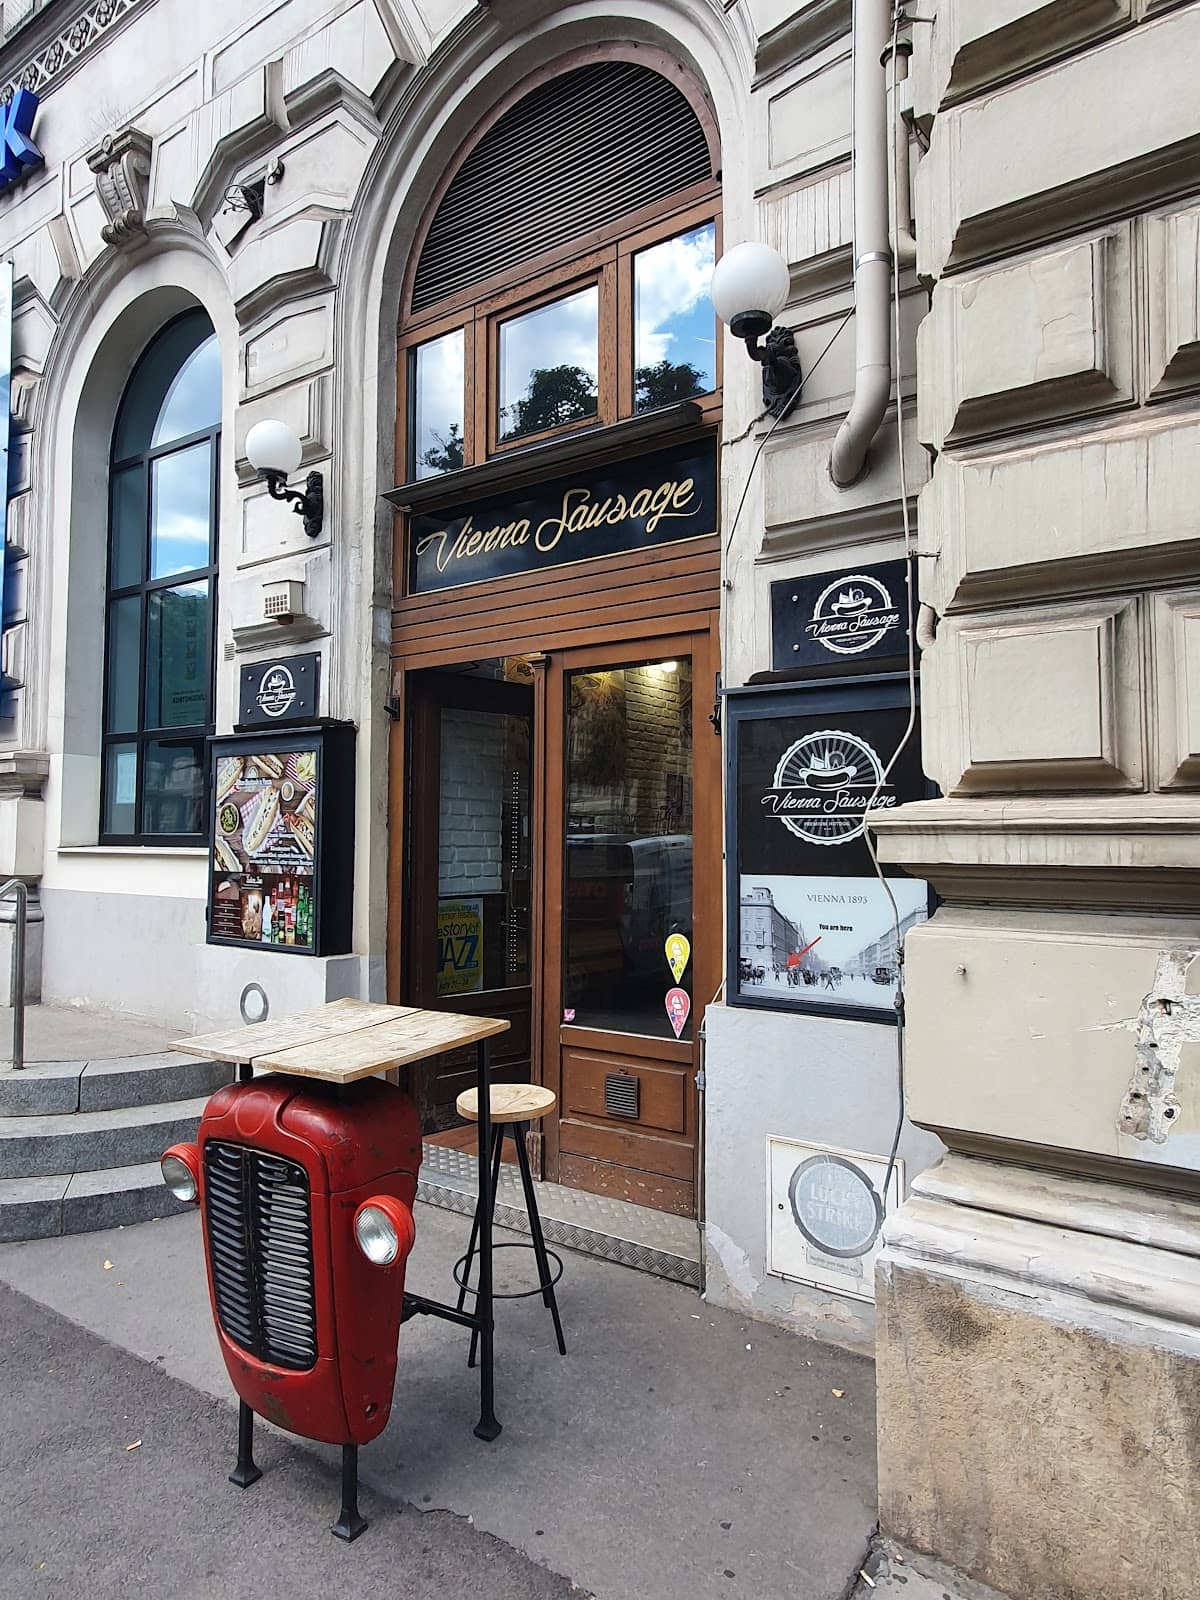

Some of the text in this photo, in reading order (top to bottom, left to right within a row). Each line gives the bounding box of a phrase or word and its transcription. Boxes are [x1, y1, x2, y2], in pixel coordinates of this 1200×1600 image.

[416, 477, 702, 573] Vienna Sausage
[804, 613, 901, 637] Vienna Sausage
[761, 791, 821, 813] Vienna
[807, 894, 868, 904] VIENNA 1893
